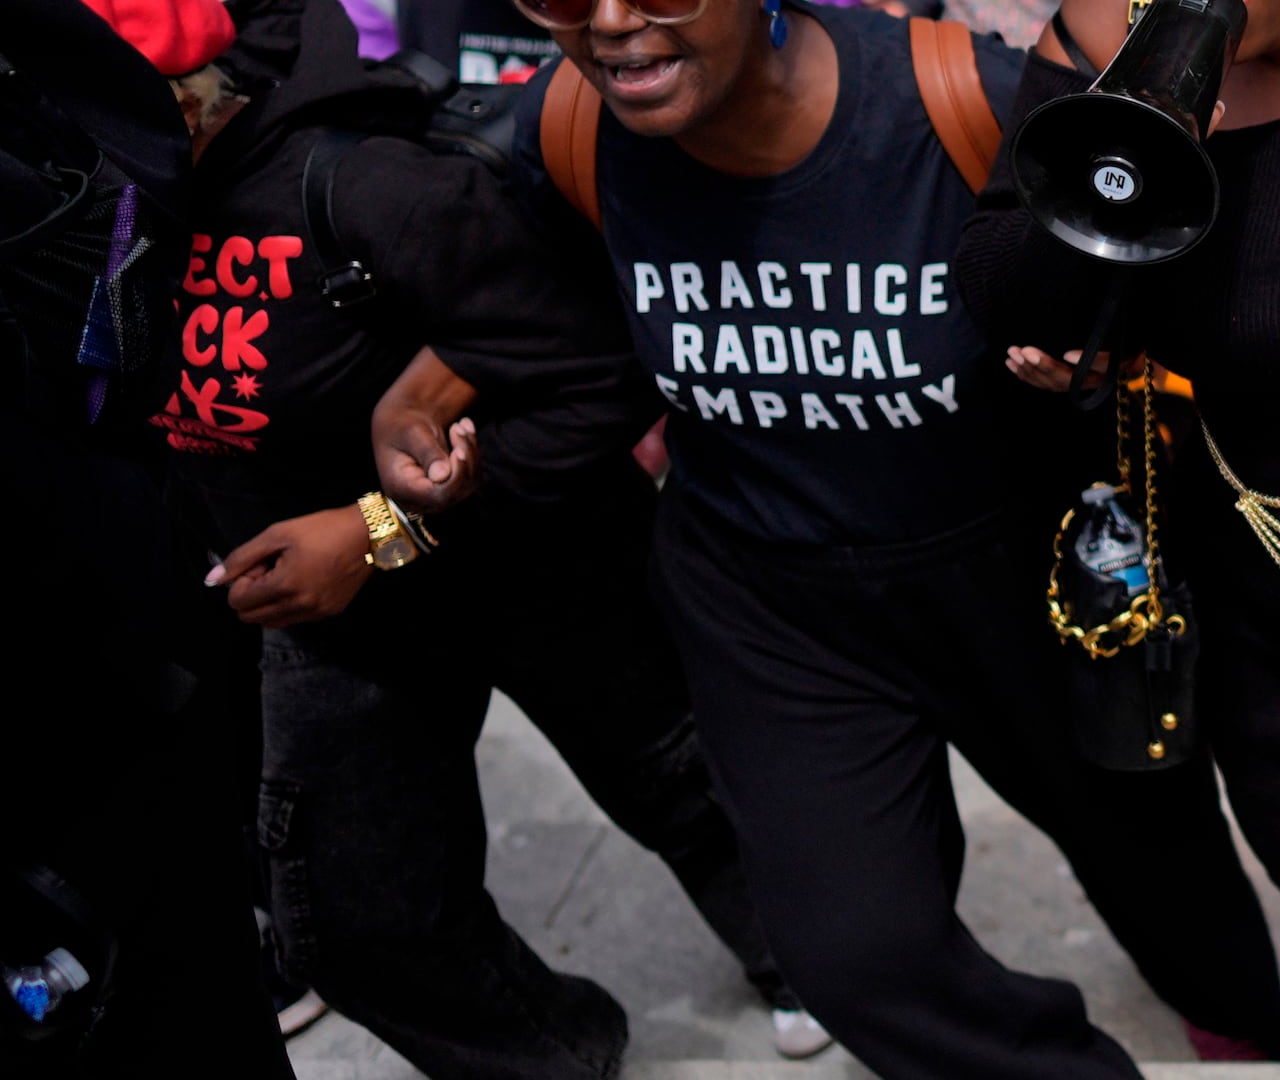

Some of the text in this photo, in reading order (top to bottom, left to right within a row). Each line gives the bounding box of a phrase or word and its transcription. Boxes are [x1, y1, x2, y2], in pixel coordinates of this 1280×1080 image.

[182, 233, 303, 300] ECT
[633, 260, 949, 316] PRACTICE
[181, 303, 270, 371] CK
[671, 322, 922, 380] RADICAL
[654, 373, 960, 431] EMPATHY
